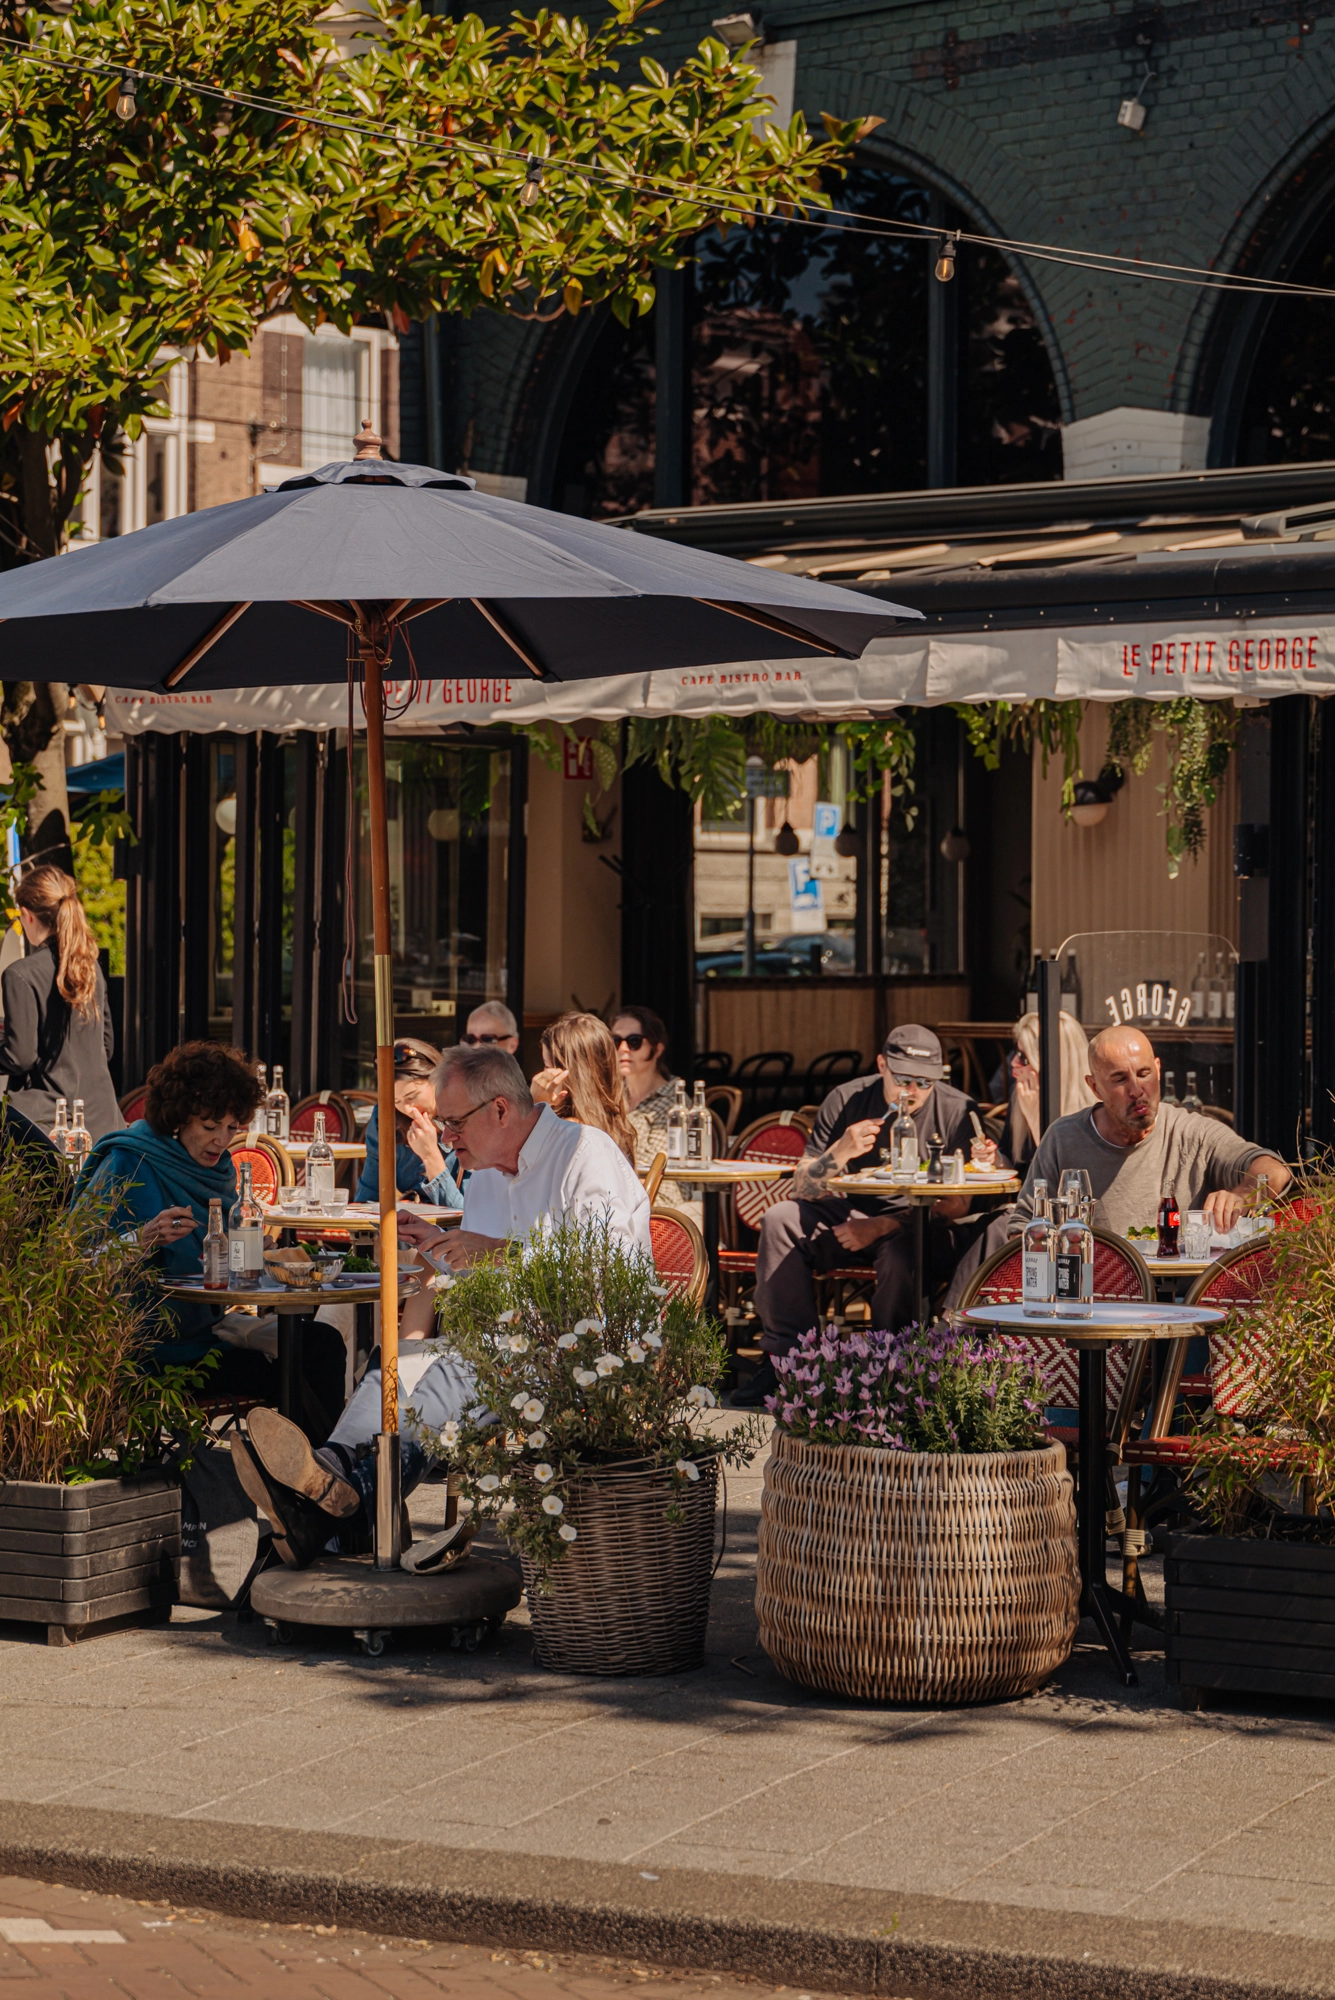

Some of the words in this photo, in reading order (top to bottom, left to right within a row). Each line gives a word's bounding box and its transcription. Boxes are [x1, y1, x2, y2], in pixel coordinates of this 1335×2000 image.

[1123, 644, 1141, 676] LE
[1151, 640, 1217, 675] PETIT
[1228, 636, 1318, 673] GEORGE
[720, 673, 769, 684] BISTRO
[775, 671, 801, 681] BAR
[443, 679, 512, 704] GEORGE
[820, 810, 835, 835] P
